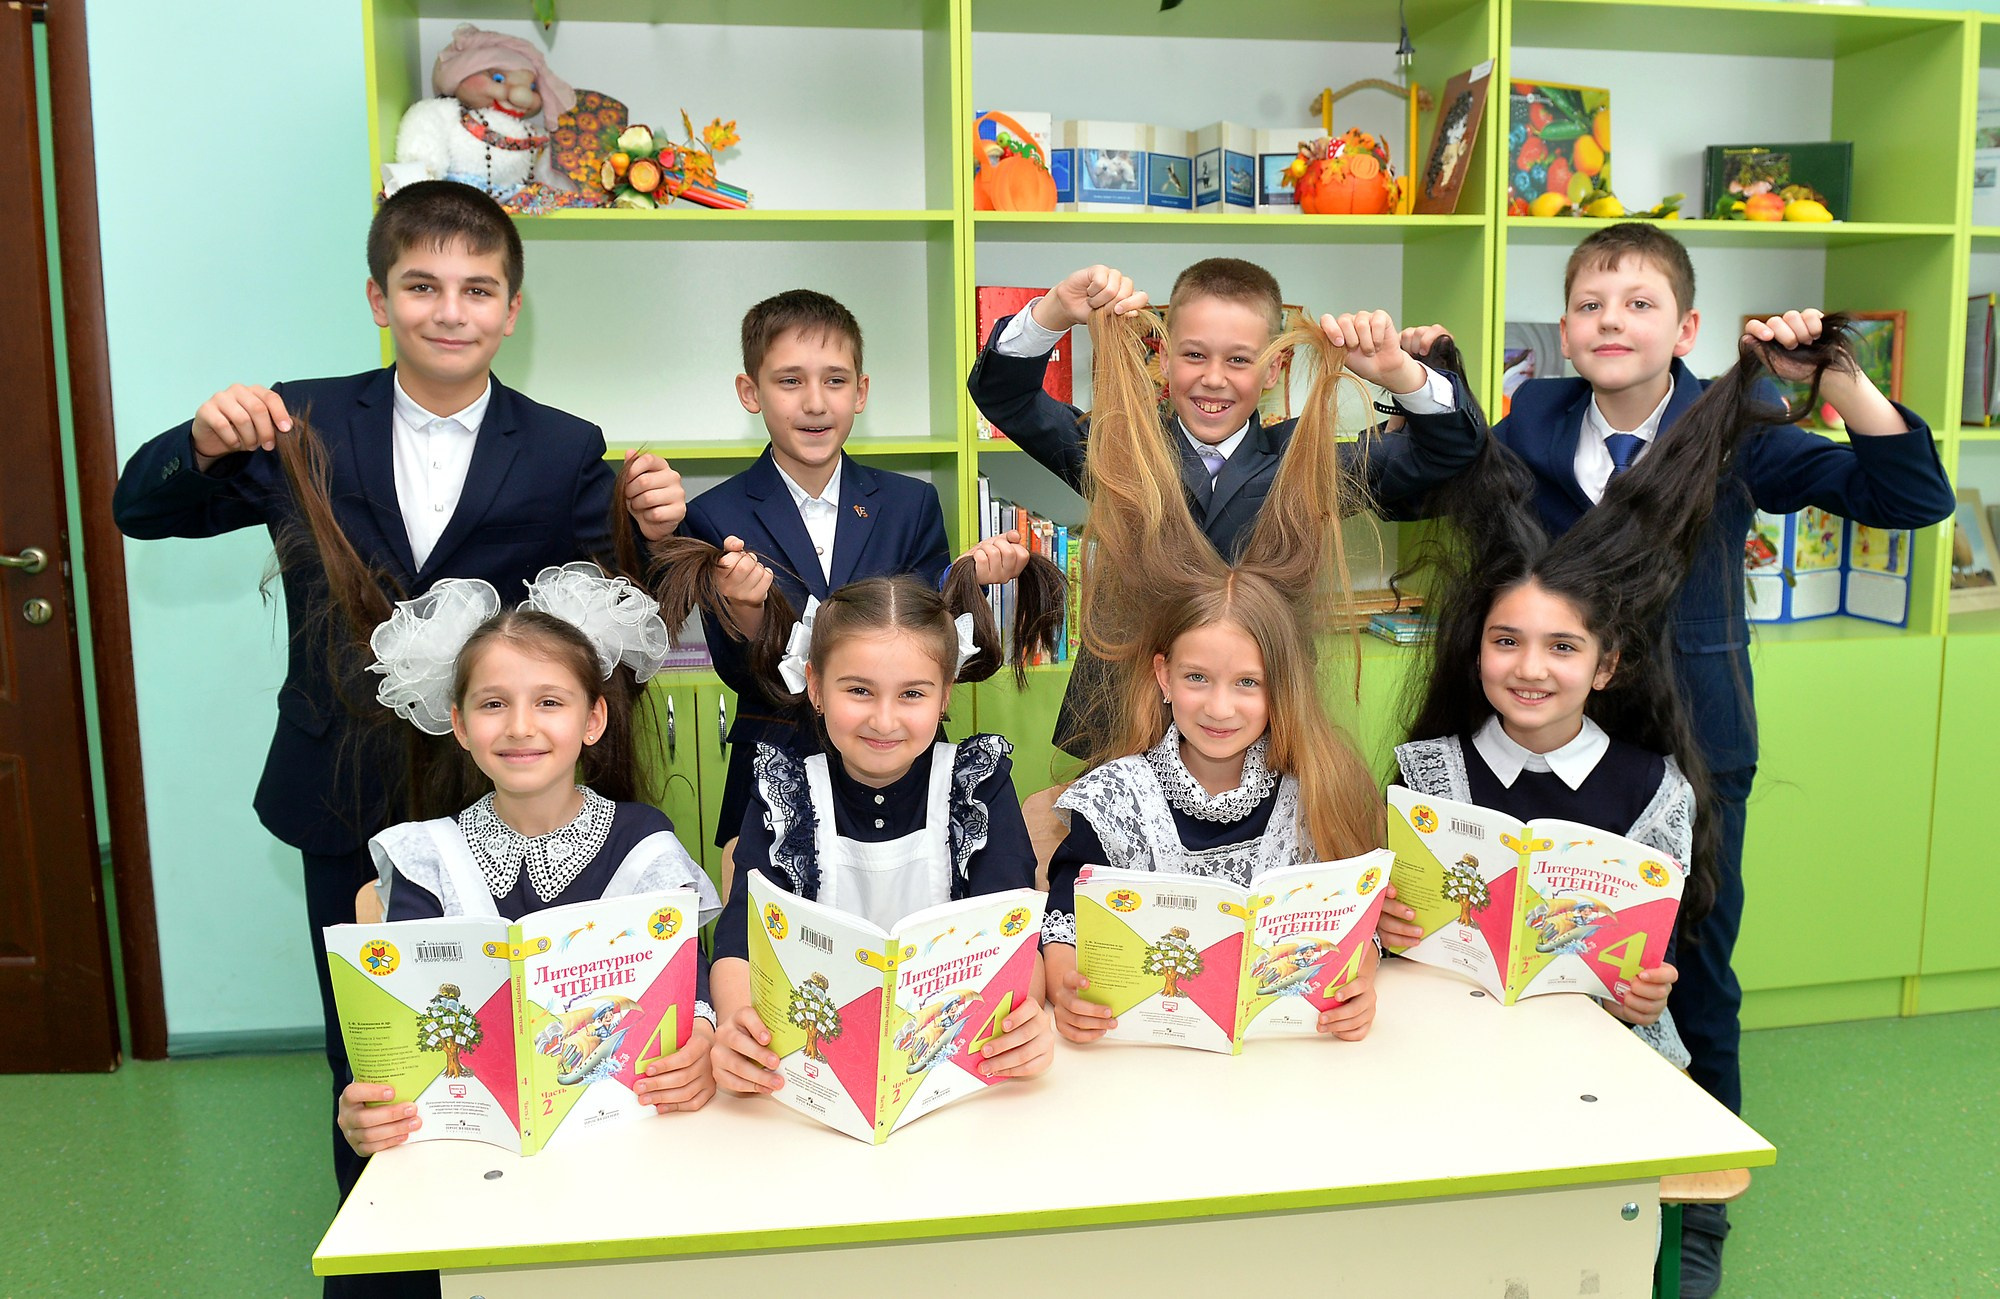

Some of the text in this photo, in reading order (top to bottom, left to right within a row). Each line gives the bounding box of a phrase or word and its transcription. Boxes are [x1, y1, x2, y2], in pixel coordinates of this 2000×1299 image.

[1533, 861, 1638, 891] Литературное
[1547, 876, 1620, 898] ЧТЕНИЕ
[1255, 904, 1357, 931] Литературное
[1268, 920, 1341, 936] ЧТЕНИЕ
[533, 950, 653, 985] Литературное
[898, 946, 1000, 990] Литературное
[1322, 941, 1364, 999] 4
[1521, 962, 1529, 974] 2
[1597, 931, 1648, 981] 4
[553, 968, 636, 999] ЧТЕНИЕ
[913, 963, 983, 997] ЧТЕНИЕ
[968, 990, 1014, 1056] 4
[634, 1003, 680, 1075] 4
[541, 1088, 567, 1098] Часть
[542, 1099, 554, 1116] 2
[892, 1088, 901, 1105] 2
